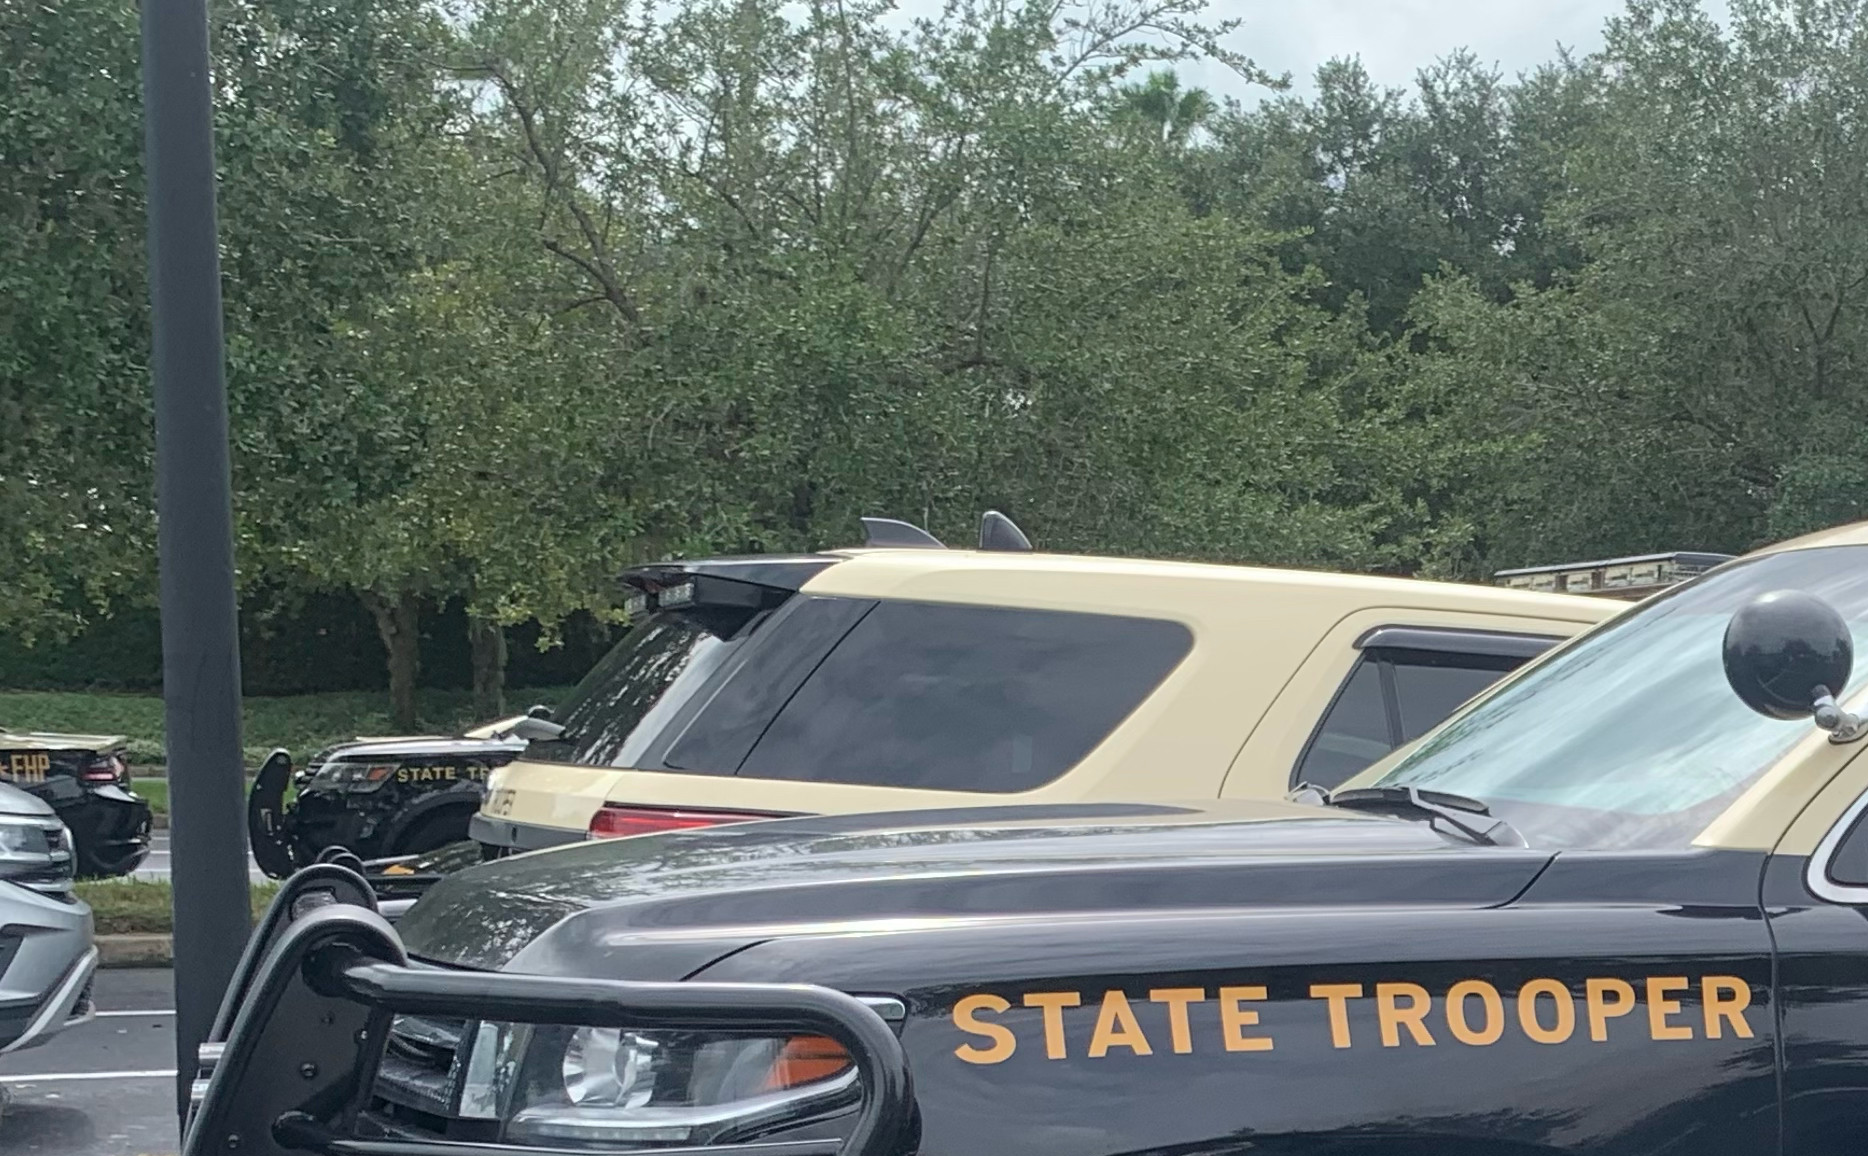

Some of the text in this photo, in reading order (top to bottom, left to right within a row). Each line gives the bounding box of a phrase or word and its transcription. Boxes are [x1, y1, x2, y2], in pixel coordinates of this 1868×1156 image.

[397, 766, 457, 783] STATE
[953, 976, 1754, 1064] STATE TROOPER
